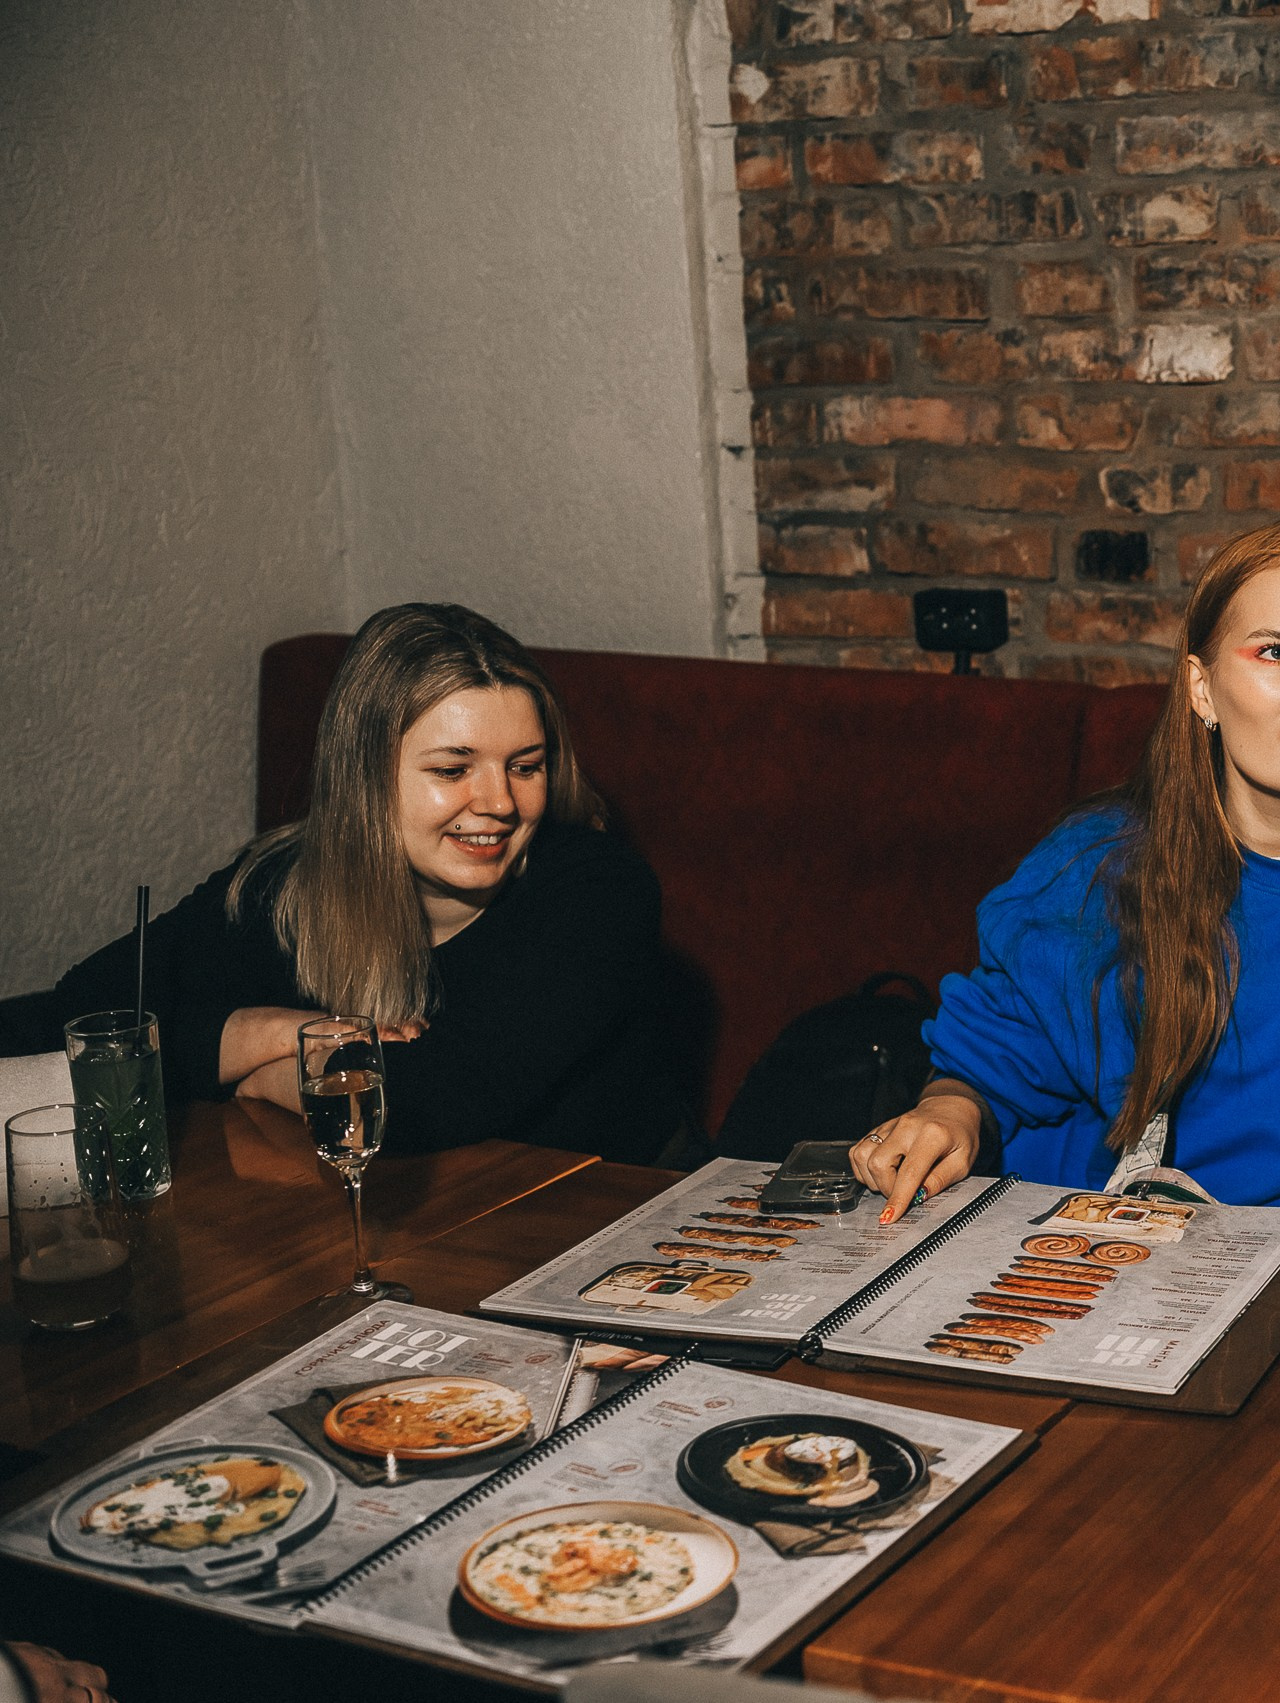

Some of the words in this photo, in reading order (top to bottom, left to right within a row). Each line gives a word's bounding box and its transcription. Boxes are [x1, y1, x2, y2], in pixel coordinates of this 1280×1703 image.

[760, 1293, 816, 1302] cue
[765, 1302, 806, 1312] be
[732, 1309, 796, 1320] bar
[294, 1342, 351, 1376] ГОРЯЧИЕ
[350, 1319, 391, 1344] БЛЮДА
[372, 1322, 479, 1352] HOT
[350, 1338, 446, 1371] TER
[1147, 1340, 1180, 1369] МАНГАЛ
